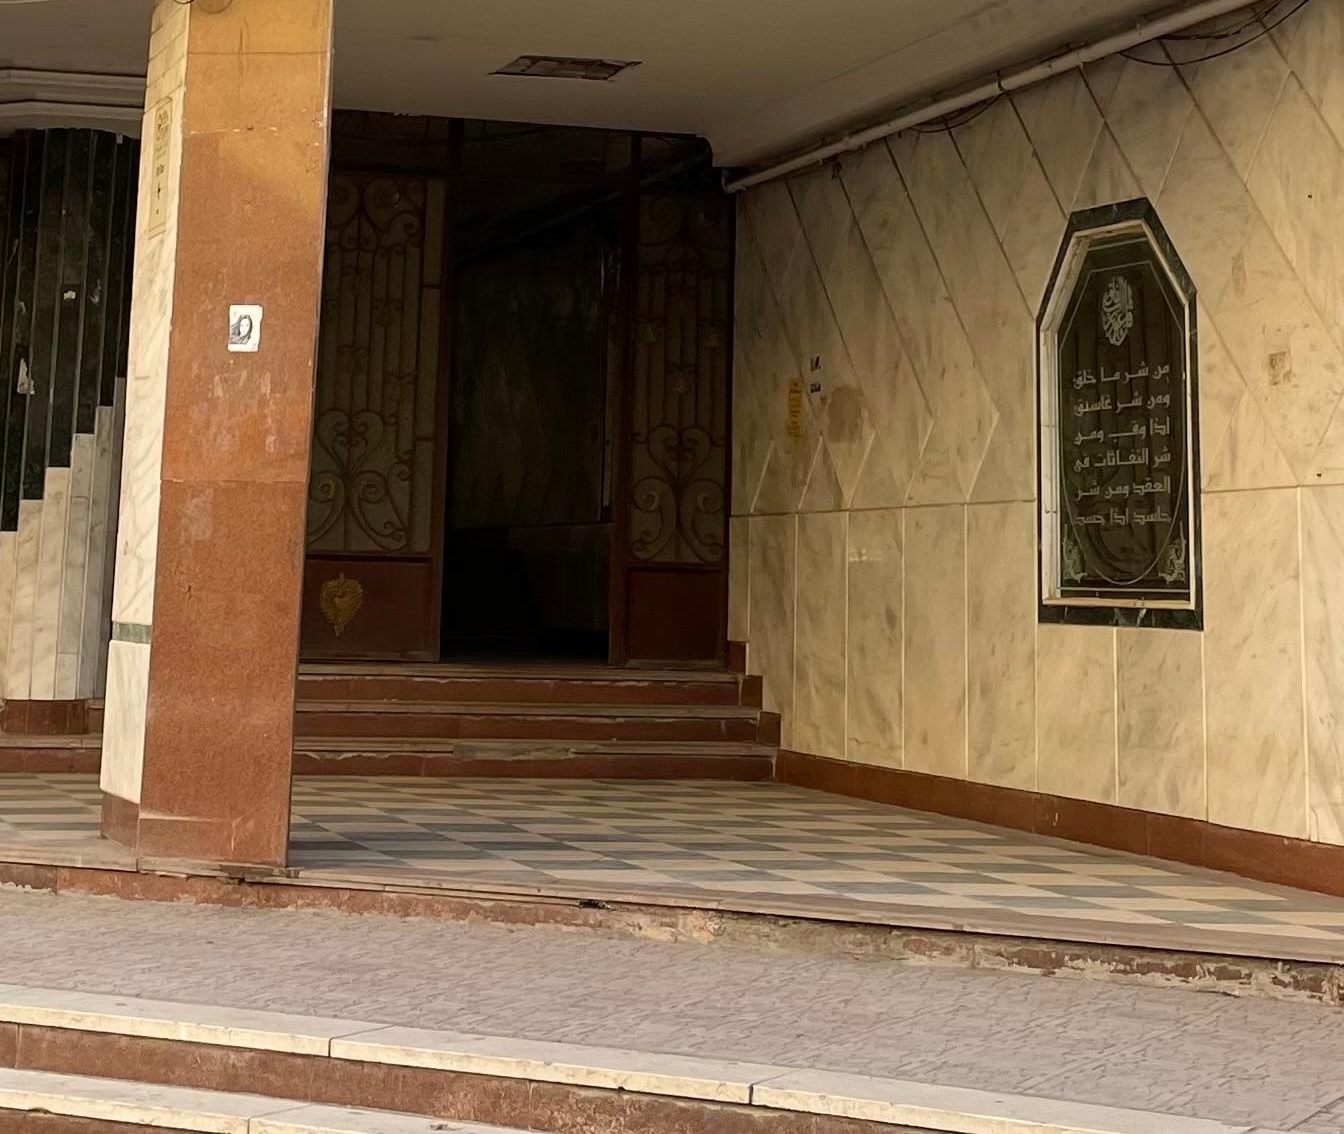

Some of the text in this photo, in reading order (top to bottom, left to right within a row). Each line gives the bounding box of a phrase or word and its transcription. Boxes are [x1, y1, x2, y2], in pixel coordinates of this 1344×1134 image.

[1073, 361, 1169, 389] من شر ما خلق
[1116, 391, 1142, 414] شر
[1147, 394, 1170, 410] ومن
[1074, 429, 1104, 445] ومن
[1108, 420, 1146, 443] وقب
[1153, 445, 1171, 468] شر
[1104, 485, 1129, 499] ومن
[1133, 475, 1171, 496] العقد
[1134, 505, 1171, 525] حاسد
